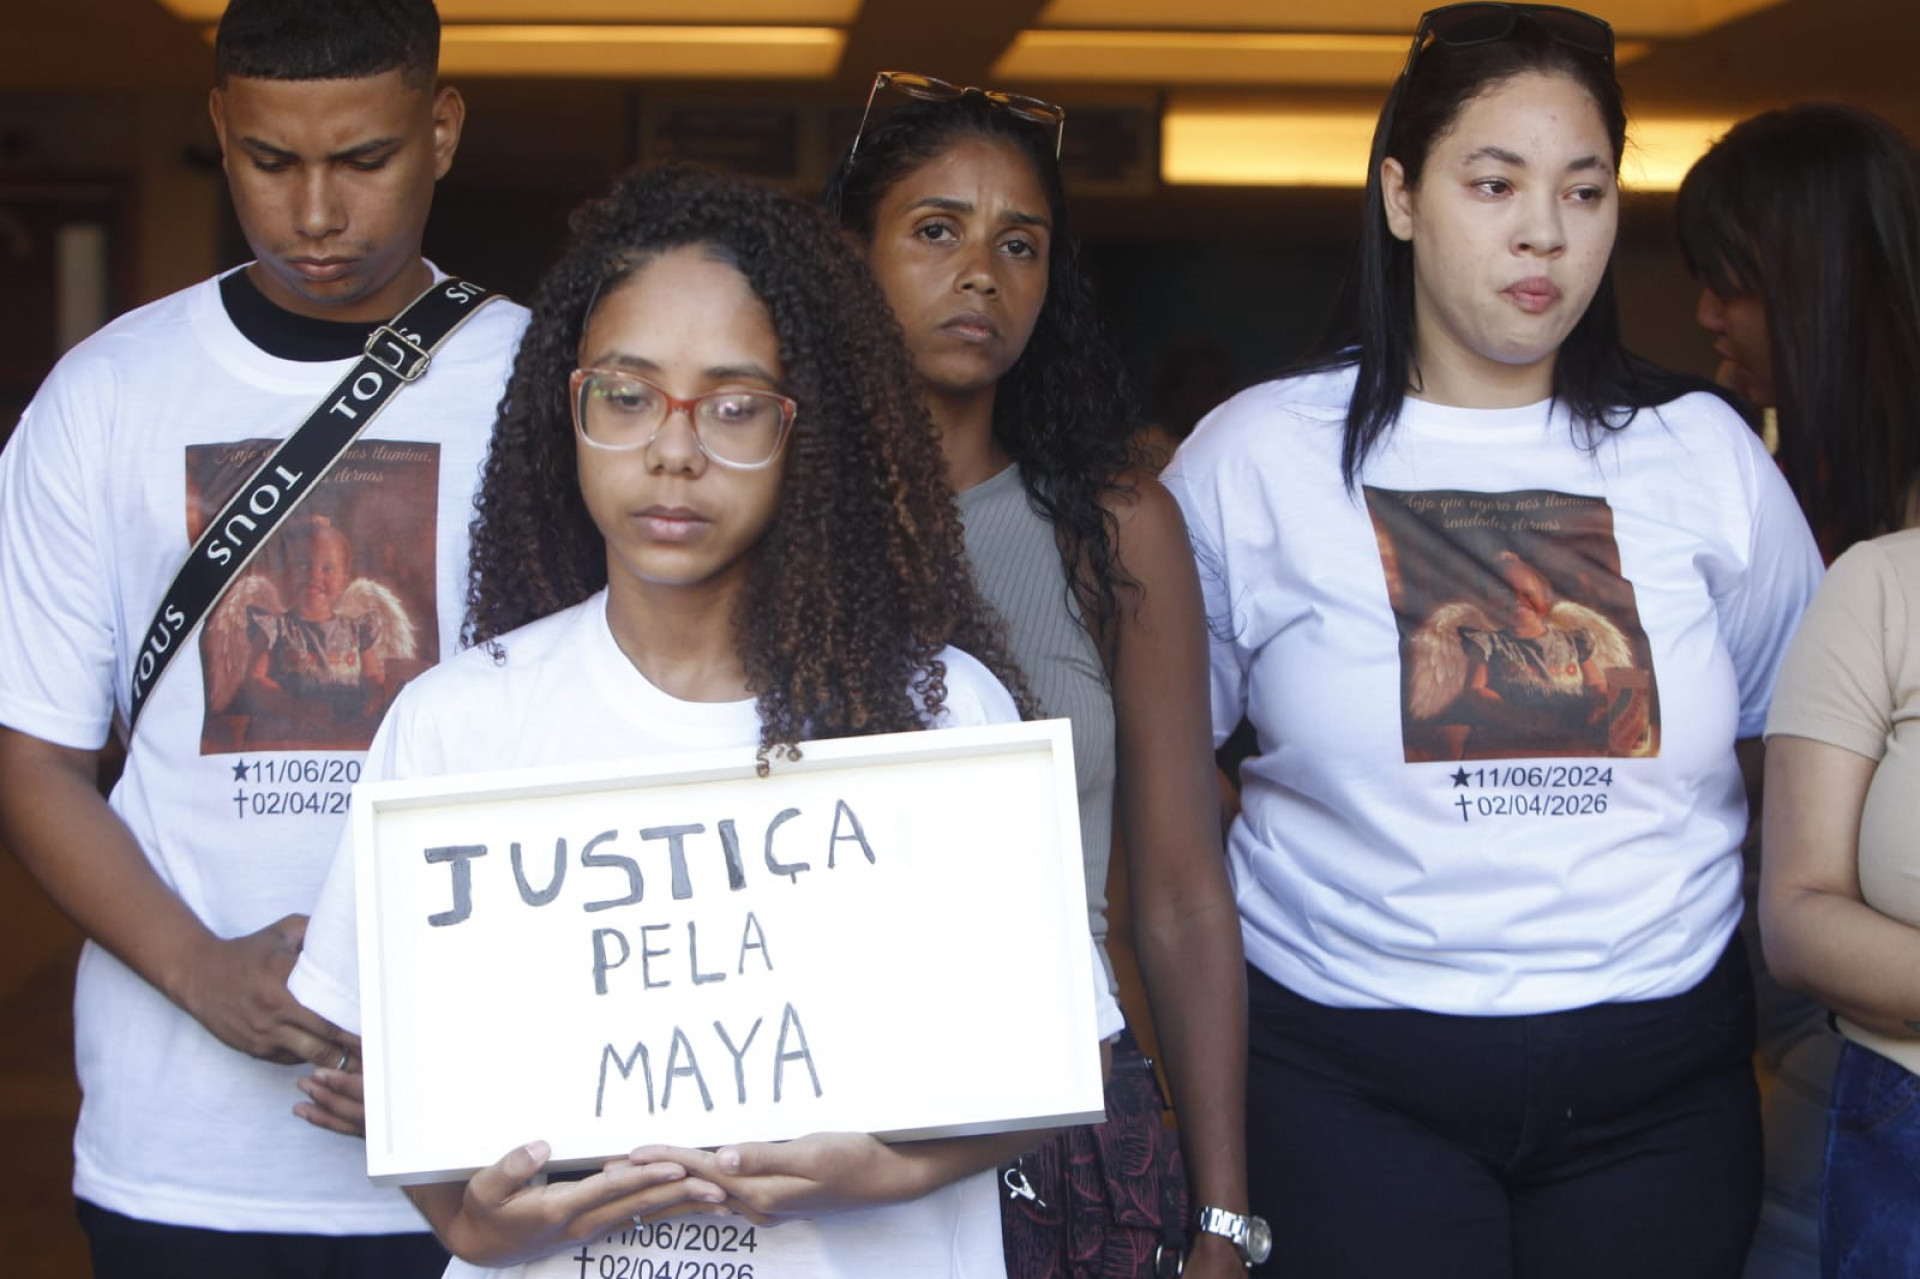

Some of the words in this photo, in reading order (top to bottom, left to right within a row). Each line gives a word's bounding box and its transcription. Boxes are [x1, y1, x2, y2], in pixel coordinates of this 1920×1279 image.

[207, 465, 303, 566] TOUS
[252, 760, 361, 783] 11/06/20
[1475, 766, 1614, 788] 11/06/2024
[252, 791, 351, 815] 02/04/2
[1477, 793, 1608, 816] 02/04/2026
[423, 799, 876, 927] JUSTIÇA
[592, 911, 774, 996] PELA
[595, 1002, 823, 1118] MAYA
[607, 1222, 757, 1253] 1/06/2024
[600, 1254, 754, 1279] 02/04/2026
